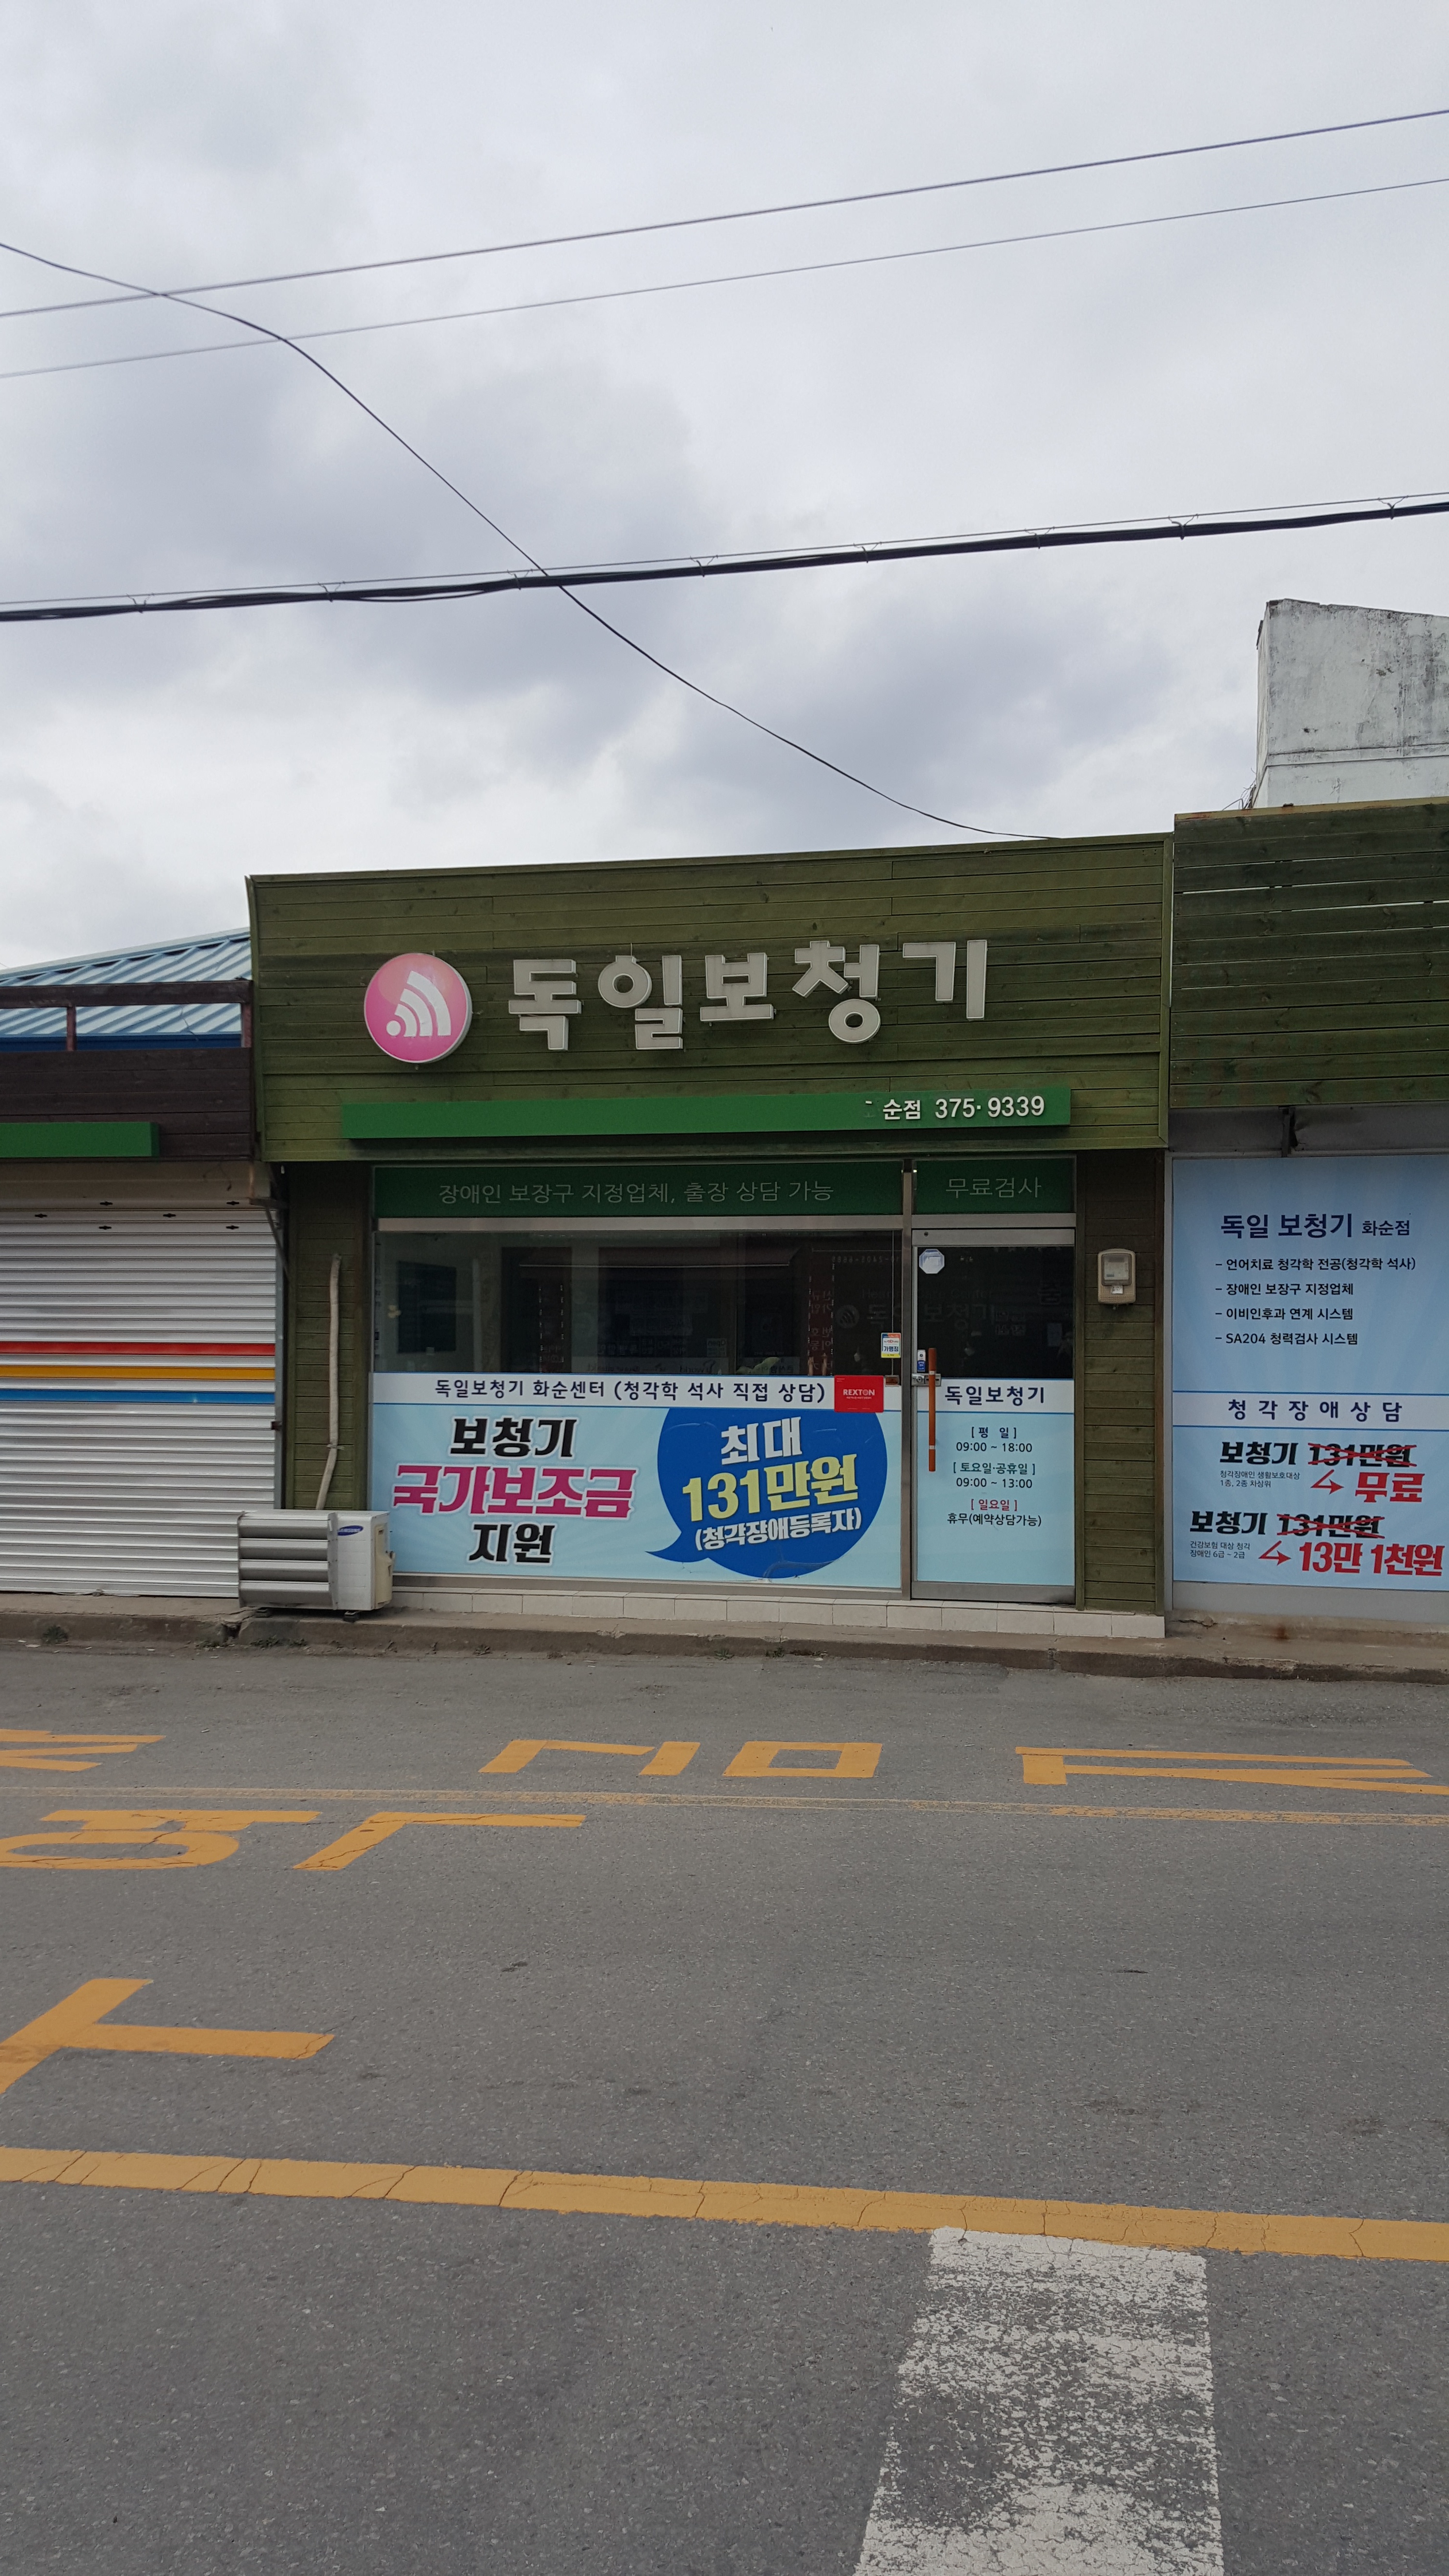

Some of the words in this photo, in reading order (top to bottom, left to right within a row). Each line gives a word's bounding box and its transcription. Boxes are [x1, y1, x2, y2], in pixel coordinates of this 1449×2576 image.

[508, 939, 988, 1050] 독일보청기
[865, 1099, 921, 1120] 순점
[439, 1184, 501, 1204] 장애인
[509, 1184, 574, 1204] 보장구
[582, 1183, 675, 1203] 지정업체,
[683, 1181, 729, 1203] 출장
[736, 1181, 781, 1202] 상담
[789, 1180, 834, 1201] 가능
[946, 1177, 1042, 1198] 무료검사
[1221, 1214, 1269, 1239] 독일
[1278, 1213, 1353, 1239] 보청기
[1361, 1220, 1411, 1236] 화순점
[1226, 1259, 1274, 1272] 언어치료
[1277, 1258, 1314, 1271] 청각학
[1318, 1257, 1383, 1271] 전공(청각학
[1387, 1257, 1416, 1271] 석사)
[1226, 1283, 1261, 1296] 장애인
[1265, 1283, 1302, 1296] 보장구
[1305, 1283, 1354, 1295] 지정업체
[1226, 1308, 1286, 1320] 이비인후과
[1289, 1307, 1313, 1320] 연계
[1317, 1307, 1353, 1320] 시스템
[1225, 1334, 1266, 1345] SA204
[1270, 1333, 1319, 1345] 청력검사
[1322, 1333, 1358, 1345] 시스템
[435, 1379, 523, 1399] 독일보청기
[533, 1379, 604, 1400] 화순센터
[614, 1380, 678, 1401] (청각학
[687, 1382, 724, 1400] 석사
[733, 1383, 769, 1402] 직접
[778, 1383, 825, 1403] 상담)
[945, 1385, 1045, 1406] 독일보청기
[450, 1417, 577, 1457] 보청기
[721, 1416, 803, 1465] 최대
[956, 1442, 987, 1451] 09:00
[1003, 1443, 1032, 1452] 18:00
[1220, 1441, 1299, 1465] 보청기
[1309, 1443, 1413, 1467] 131만원
[956, 1478, 987, 1487] 09:00
[1003, 1478, 1032, 1488] 13:00
[1220, 1470, 1255, 1479] 청각장애인
[1257, 1471, 1301, 1480] 생활보호대상
[393, 1465, 637, 1519] 국가보조금
[682, 1453, 858, 1522] 131만원
[1355, 1472, 1425, 1503] 무료
[695, 1507, 862, 1551] (청각장애등록자)
[947, 1513, 1042, 1527] 휴무(예약상담가능)
[1190, 1511, 1268, 1535] 보청기
[1278, 1513, 1382, 1538] 131만원
[468, 1523, 555, 1563] 지원
[1190, 1541, 1218, 1549] 건강보험
[1299, 1542, 1363, 1574] 13만
[1370, 1544, 1445, 1577] 1천원
